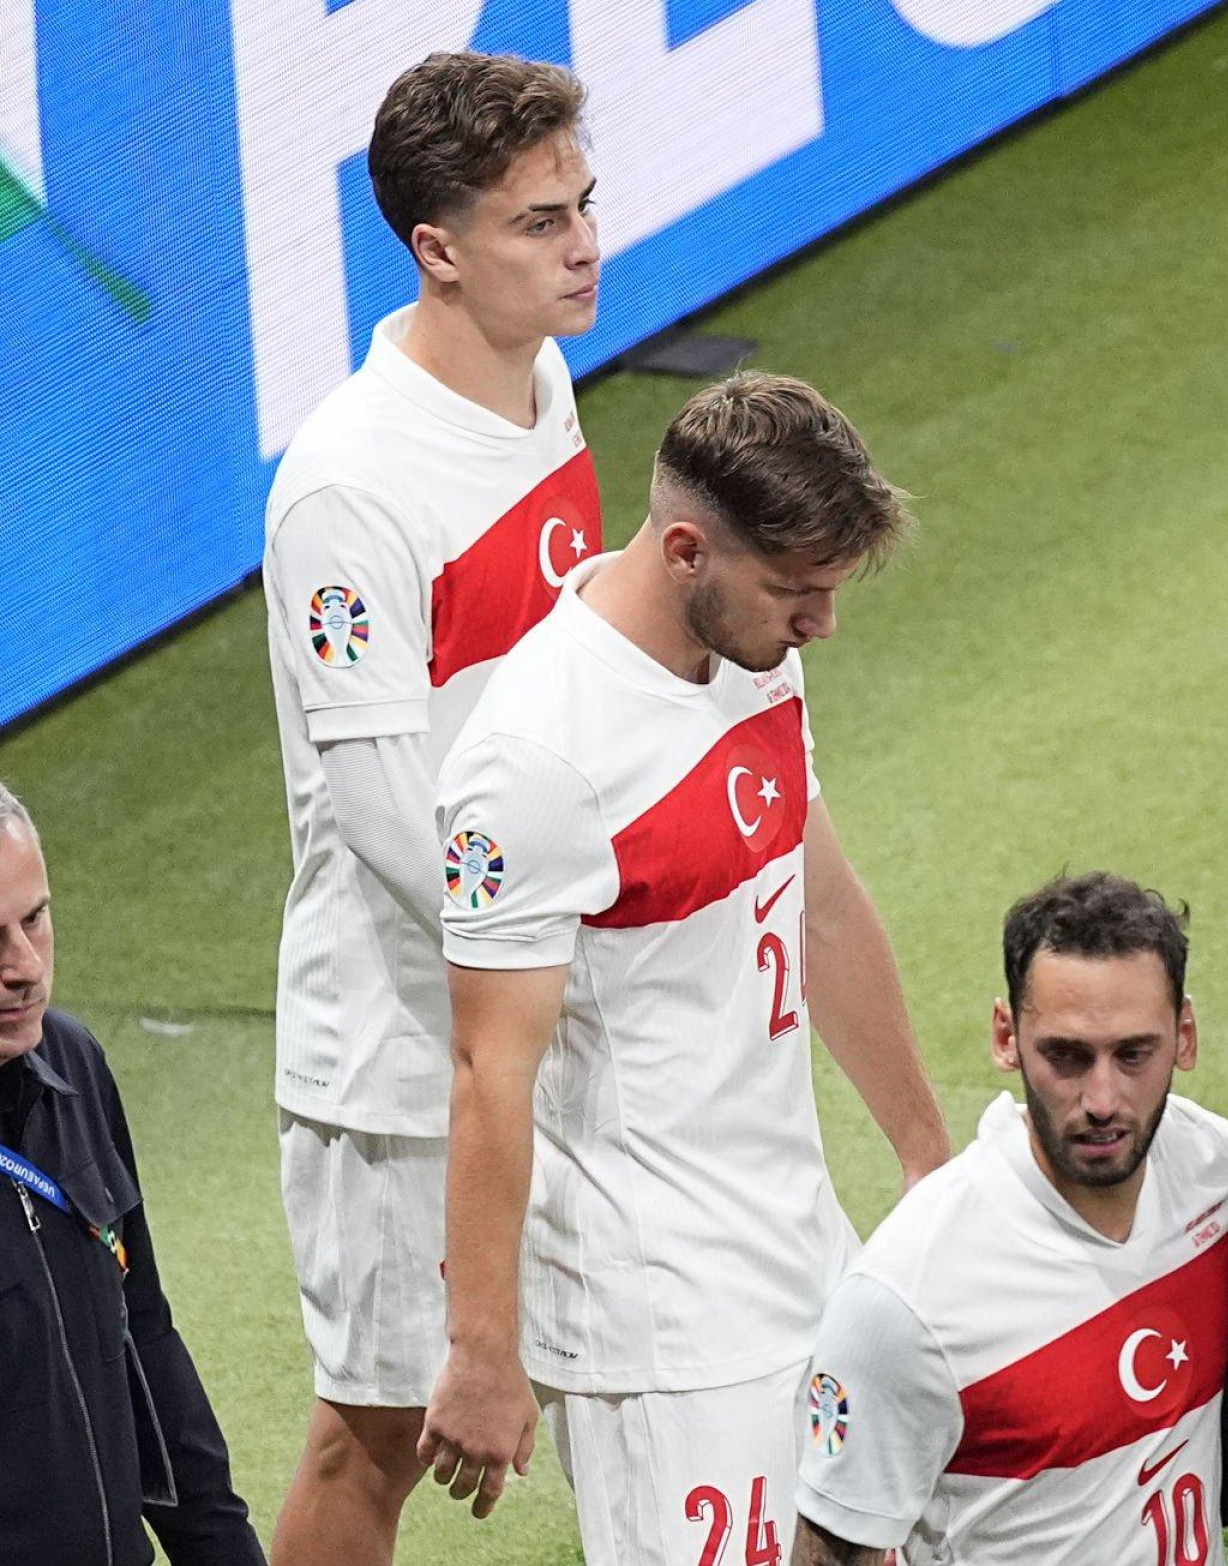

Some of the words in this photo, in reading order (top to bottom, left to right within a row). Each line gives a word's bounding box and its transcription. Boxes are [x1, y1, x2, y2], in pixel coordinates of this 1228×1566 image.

[757, 932, 806, 1040] 2
[685, 1476, 781, 1566] 24
[1141, 1473, 1208, 1566] 10
